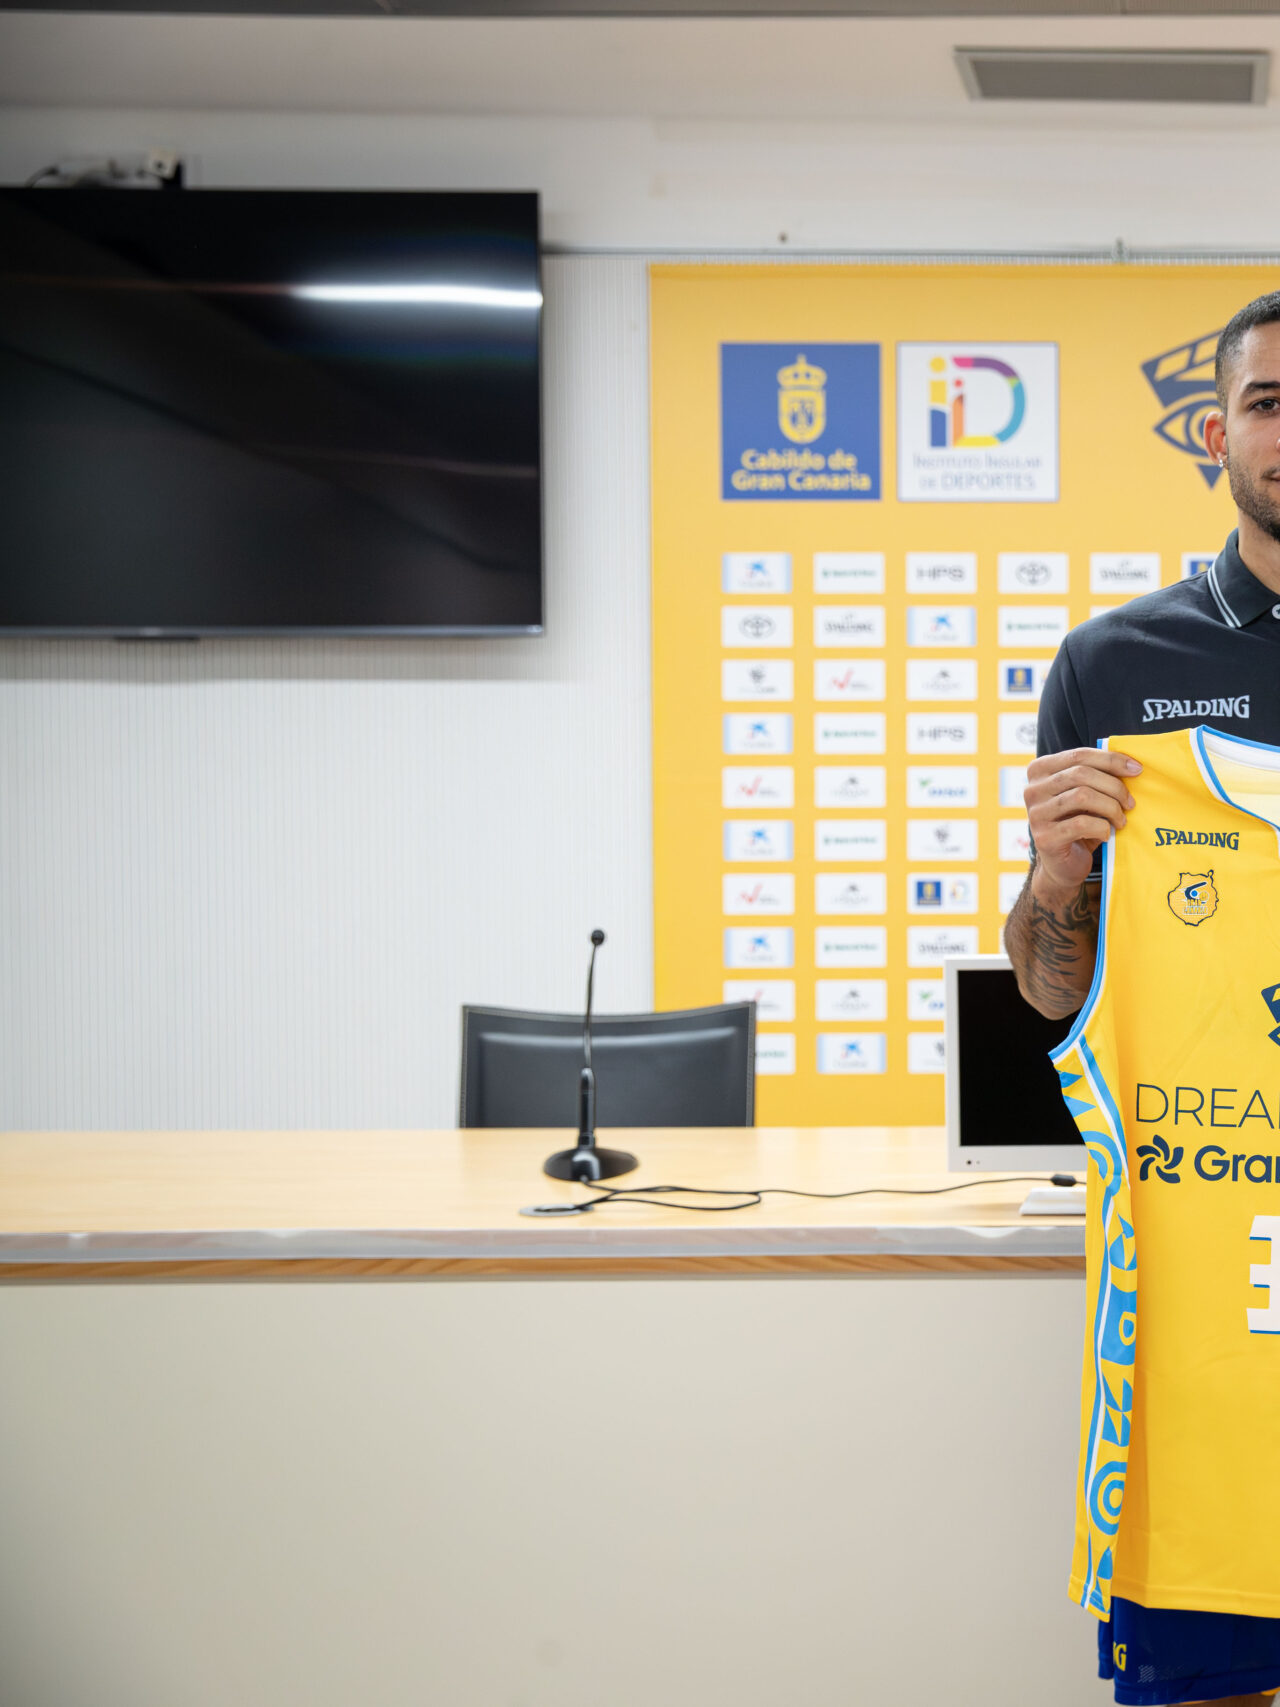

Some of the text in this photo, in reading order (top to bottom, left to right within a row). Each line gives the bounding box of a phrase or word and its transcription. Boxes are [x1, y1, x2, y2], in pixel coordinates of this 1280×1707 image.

[741, 449, 857, 471] Cabildo de
[732, 470, 871, 491] Gran Canaria
[1142, 695, 1250, 723] SPALDING
[1155, 827, 1240, 851] SPALDING
